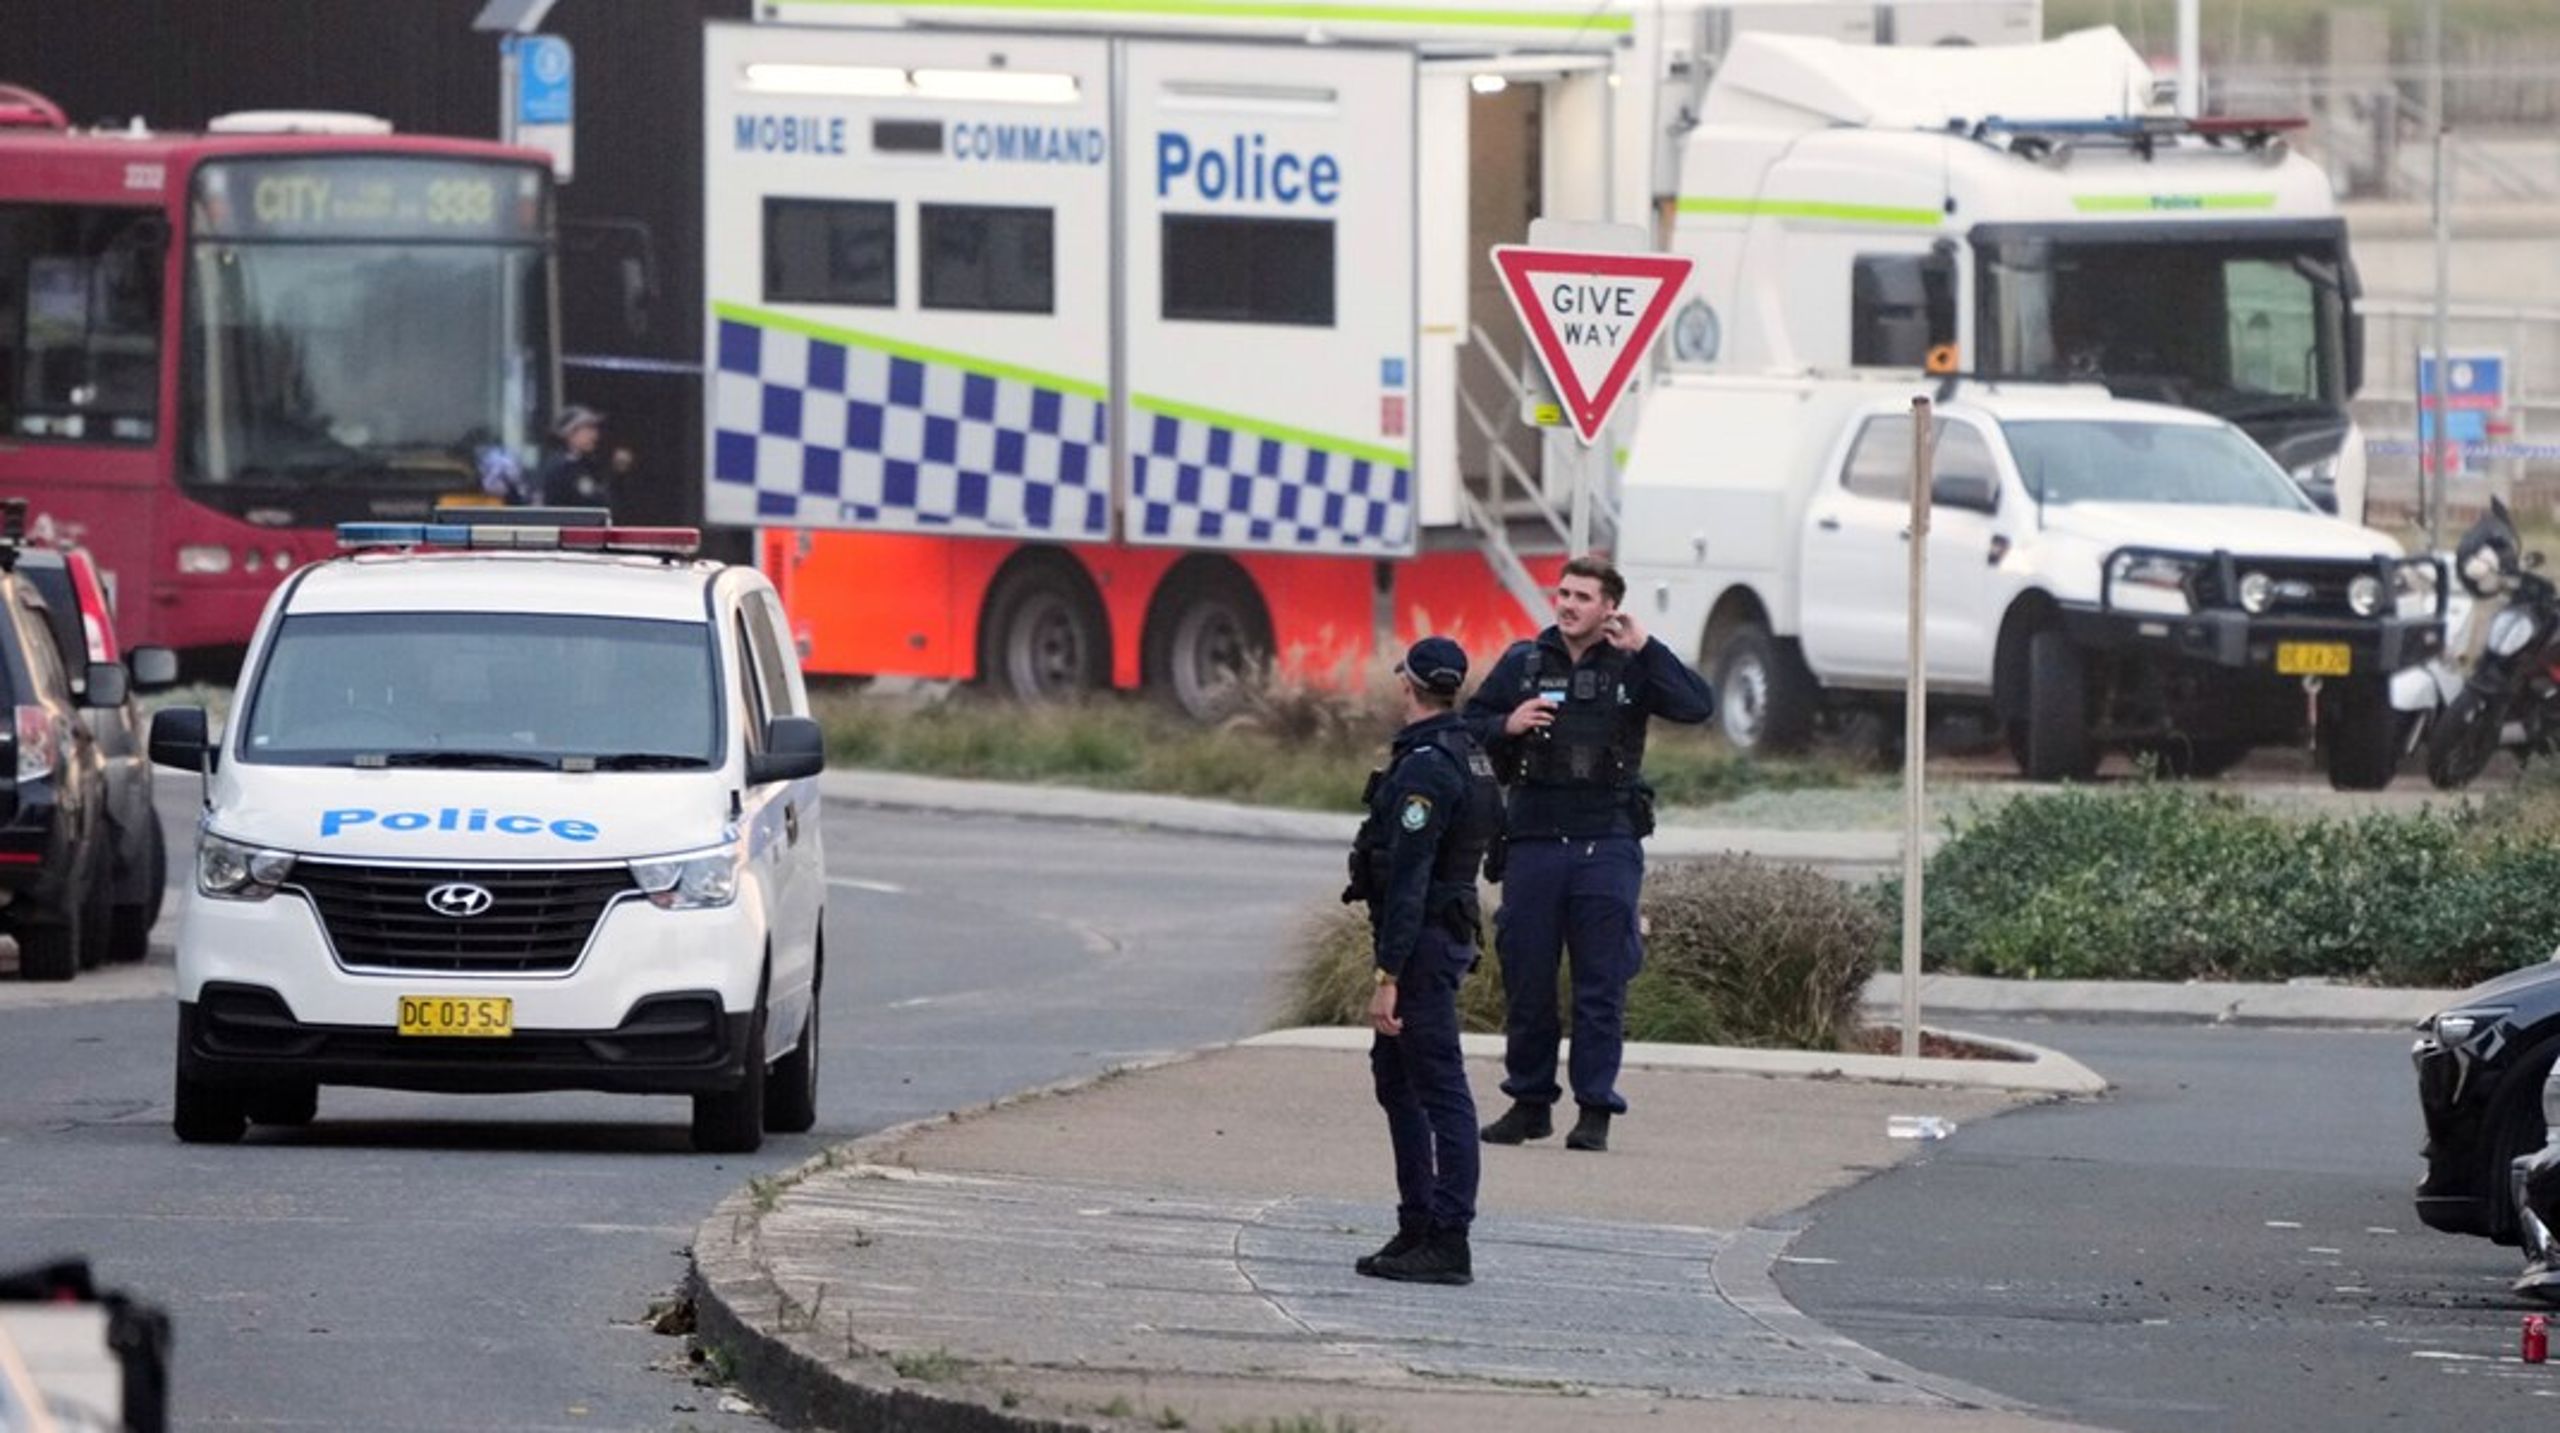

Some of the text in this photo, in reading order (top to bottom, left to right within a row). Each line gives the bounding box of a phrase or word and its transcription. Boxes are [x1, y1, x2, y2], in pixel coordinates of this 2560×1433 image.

[735, 115, 1103, 165] MOBILE COMMAND
[1158, 131, 1340, 204] Police
[254, 176, 331, 222] CITY
[1553, 284, 1635, 316] GIVE
[1564, 323, 1622, 347] WAY
[319, 807, 600, 842] Police
[403, 1002, 508, 1027] DC 03 SJ
